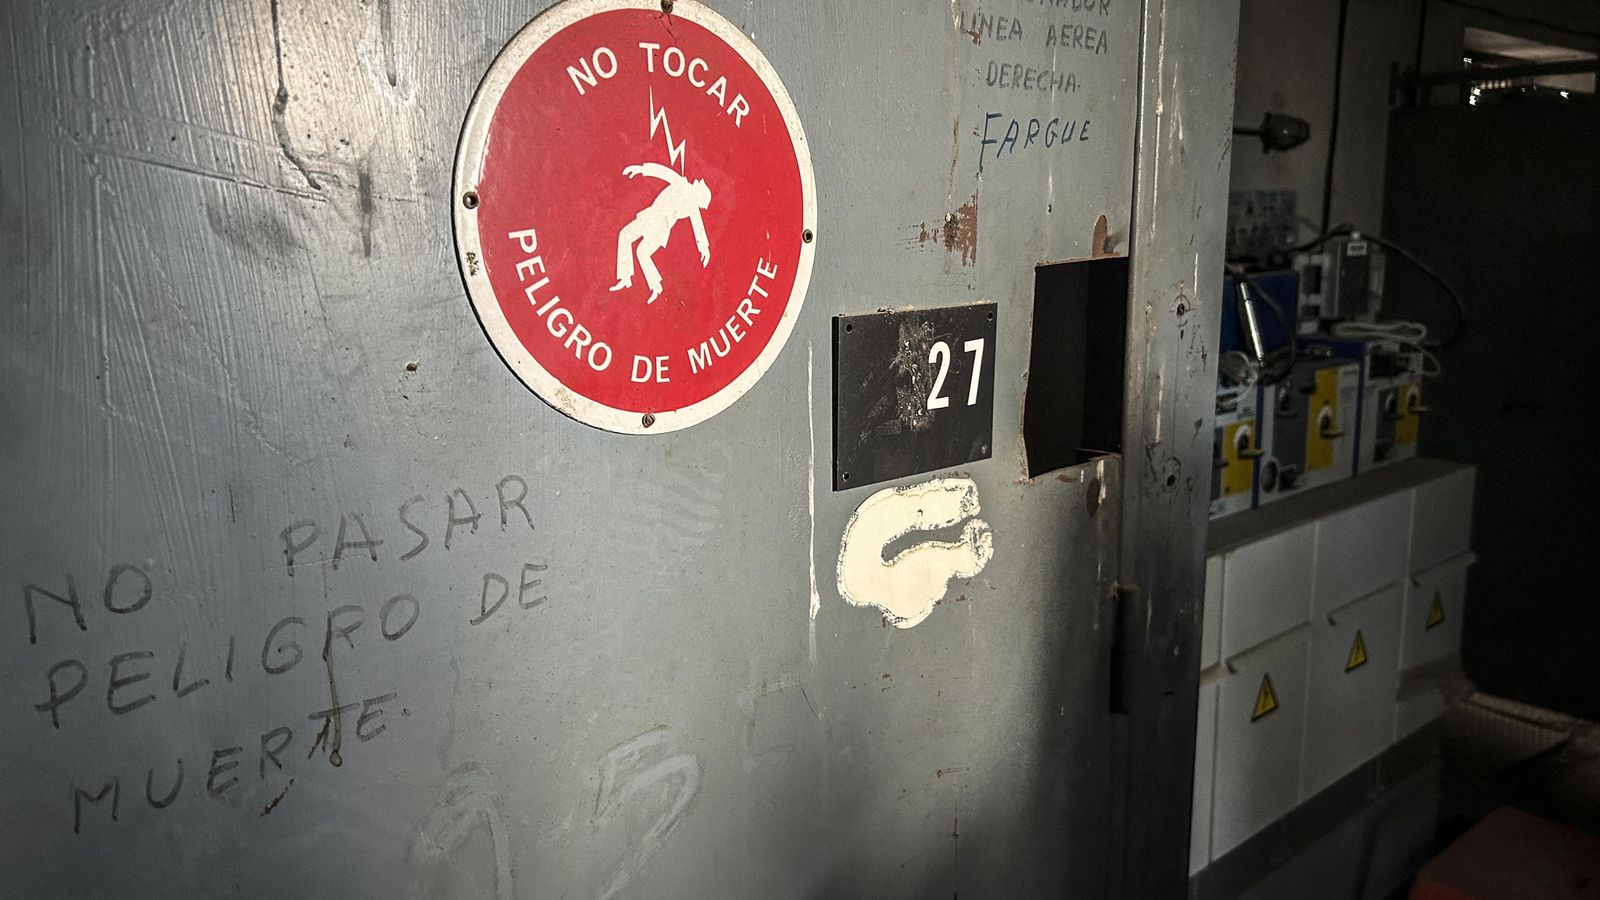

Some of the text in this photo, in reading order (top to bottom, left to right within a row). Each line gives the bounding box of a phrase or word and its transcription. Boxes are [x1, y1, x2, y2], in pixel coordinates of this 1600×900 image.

[1045, 23, 1108, 54] AEREA
[566, 42, 750, 128] NO TOCAR
[978, 112, 1090, 174] FARGUE
[508, 228, 778, 383] PELIGRO DE MUERTE
[926, 338, 985, 410] 27
[23, 475, 536, 644] NO PASAR
[35, 562, 549, 730] PELIGRO DE
